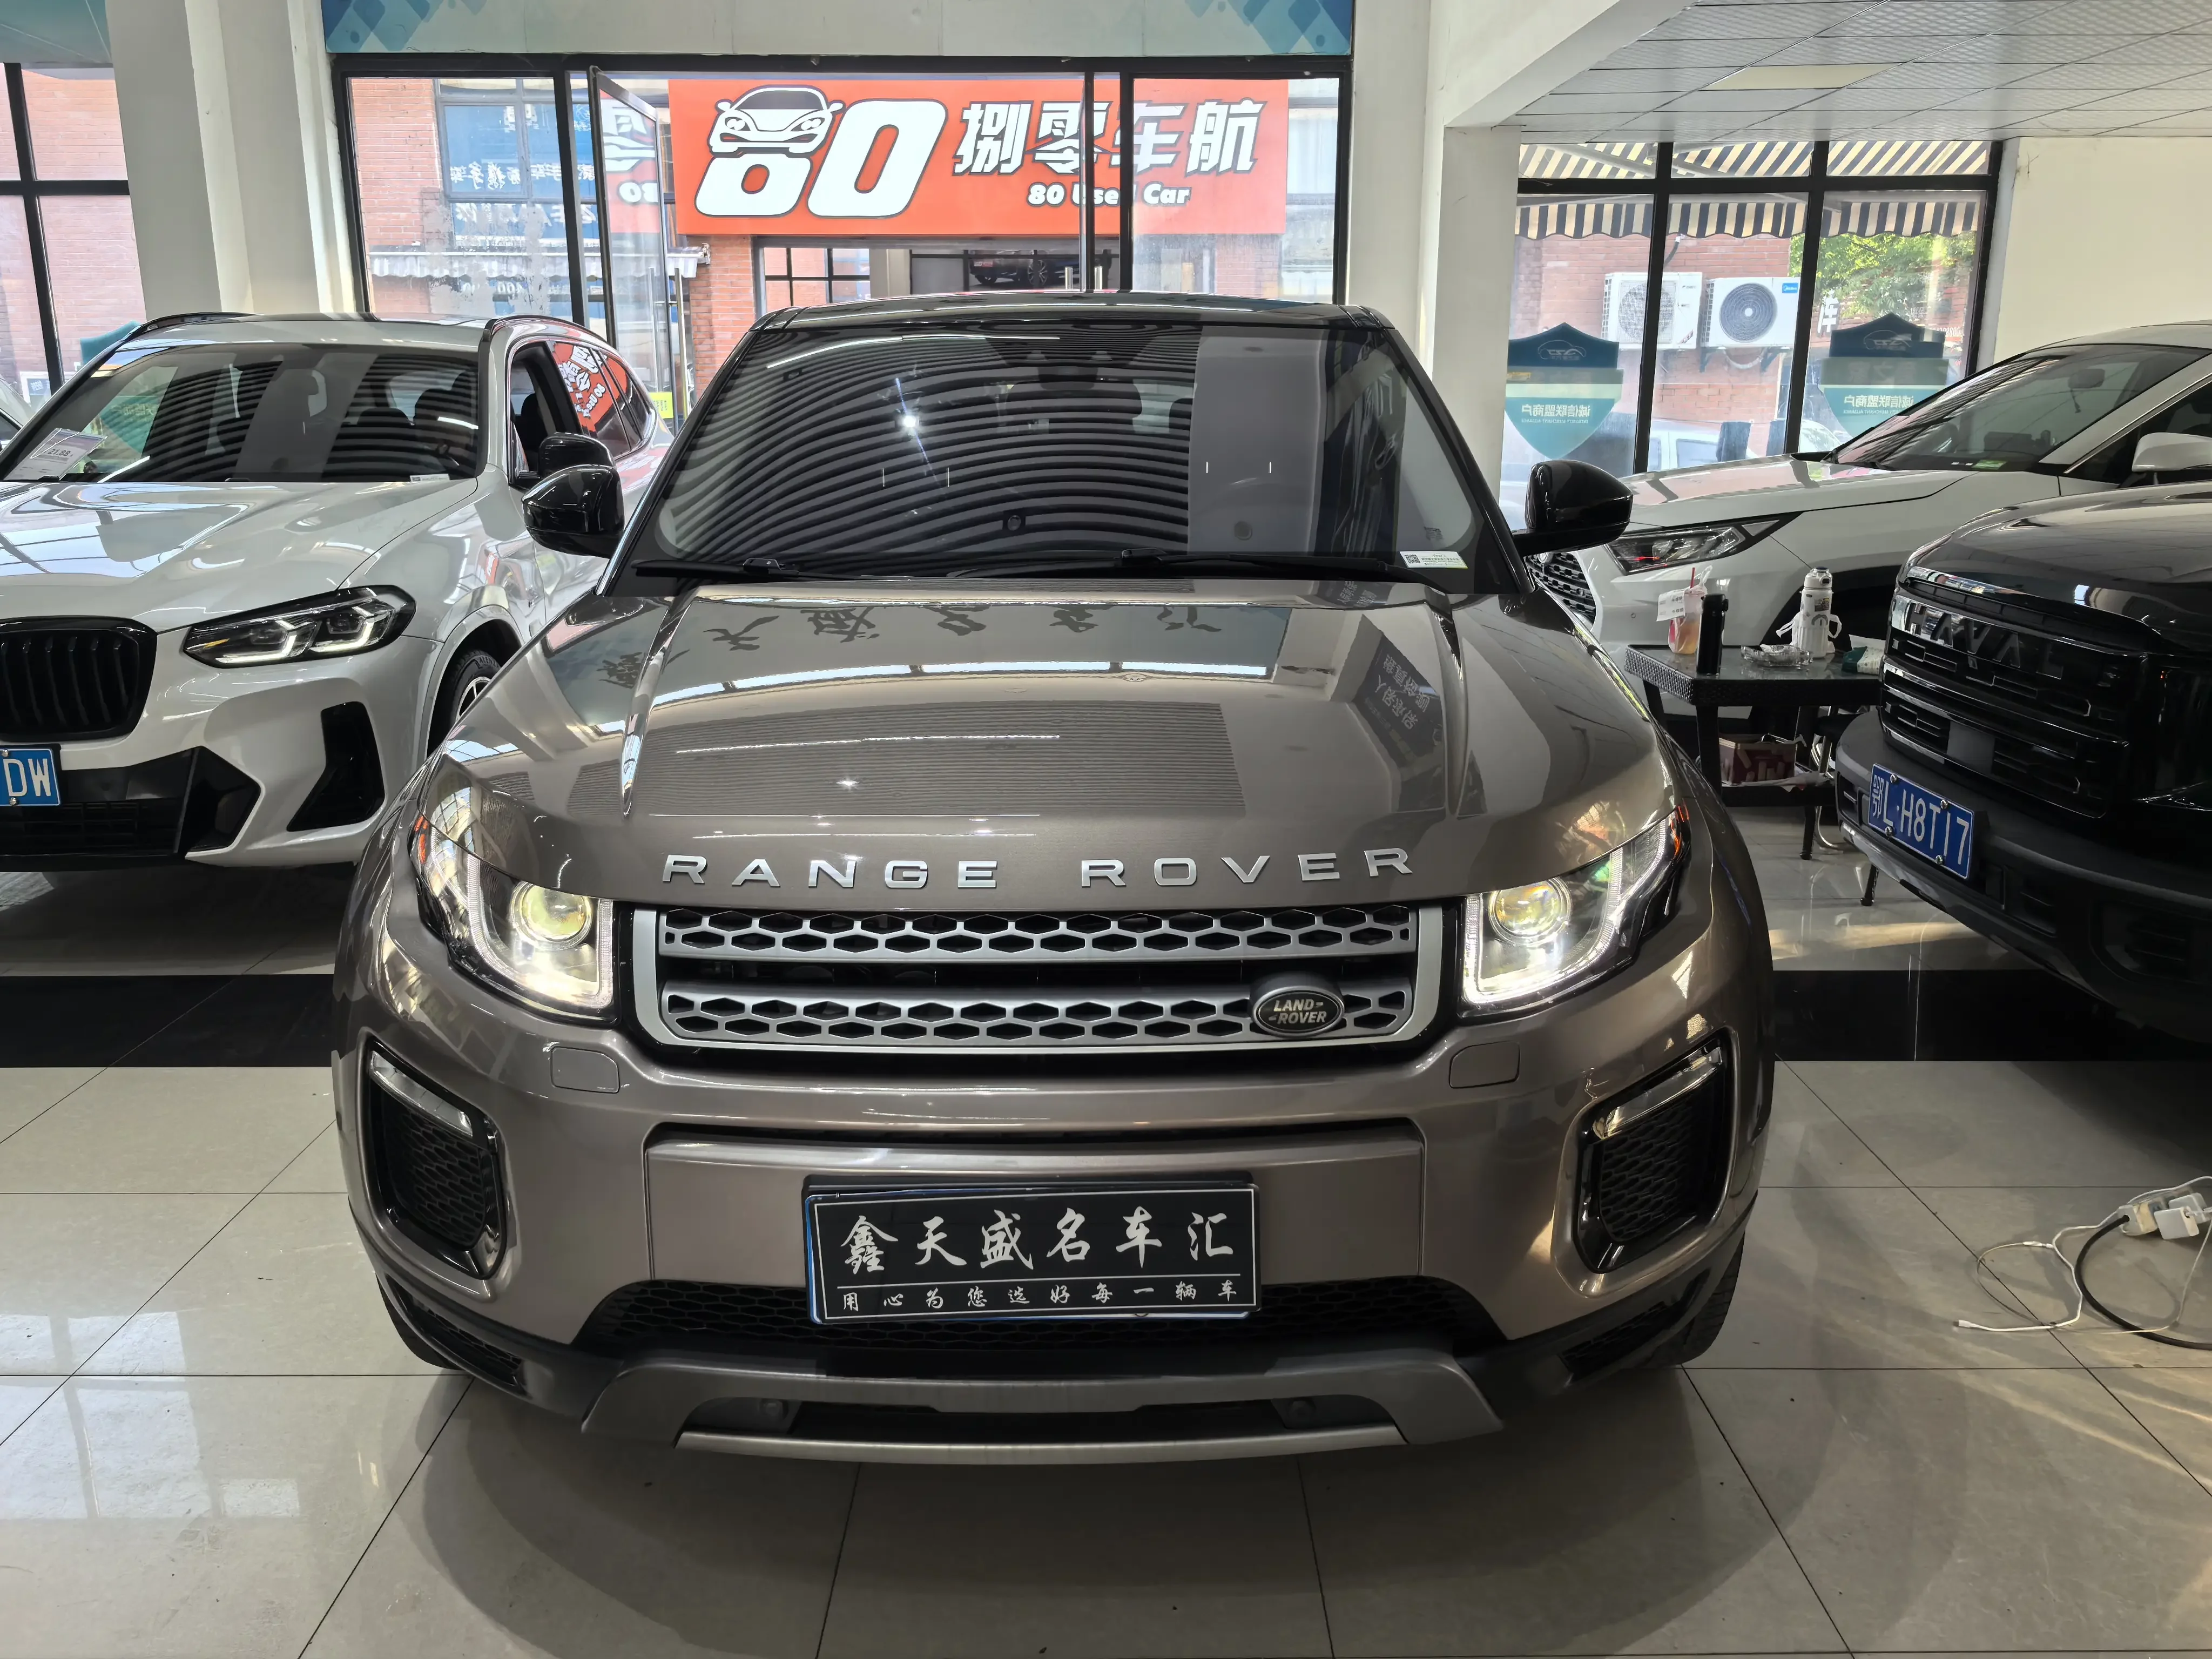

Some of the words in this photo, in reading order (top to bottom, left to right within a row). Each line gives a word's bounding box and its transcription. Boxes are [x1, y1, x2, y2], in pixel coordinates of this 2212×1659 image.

[695, 85, 946, 217] 80
[1027, 181, 1067, 206] 80
[1071, 181, 1136, 206] Use
[1142, 181, 1191, 206] Car
[662, 854, 997, 889] RANGE
[1081, 848, 1413, 887] ROVER
[1273, 999, 1314, 1012] LAND
[1277, 1011, 1327, 1024] ROVER
[840, 1206, 1233, 1276] 鑫天盛名车汇
[842, 1280, 1237, 1311] 用心为您选好每一辆车
